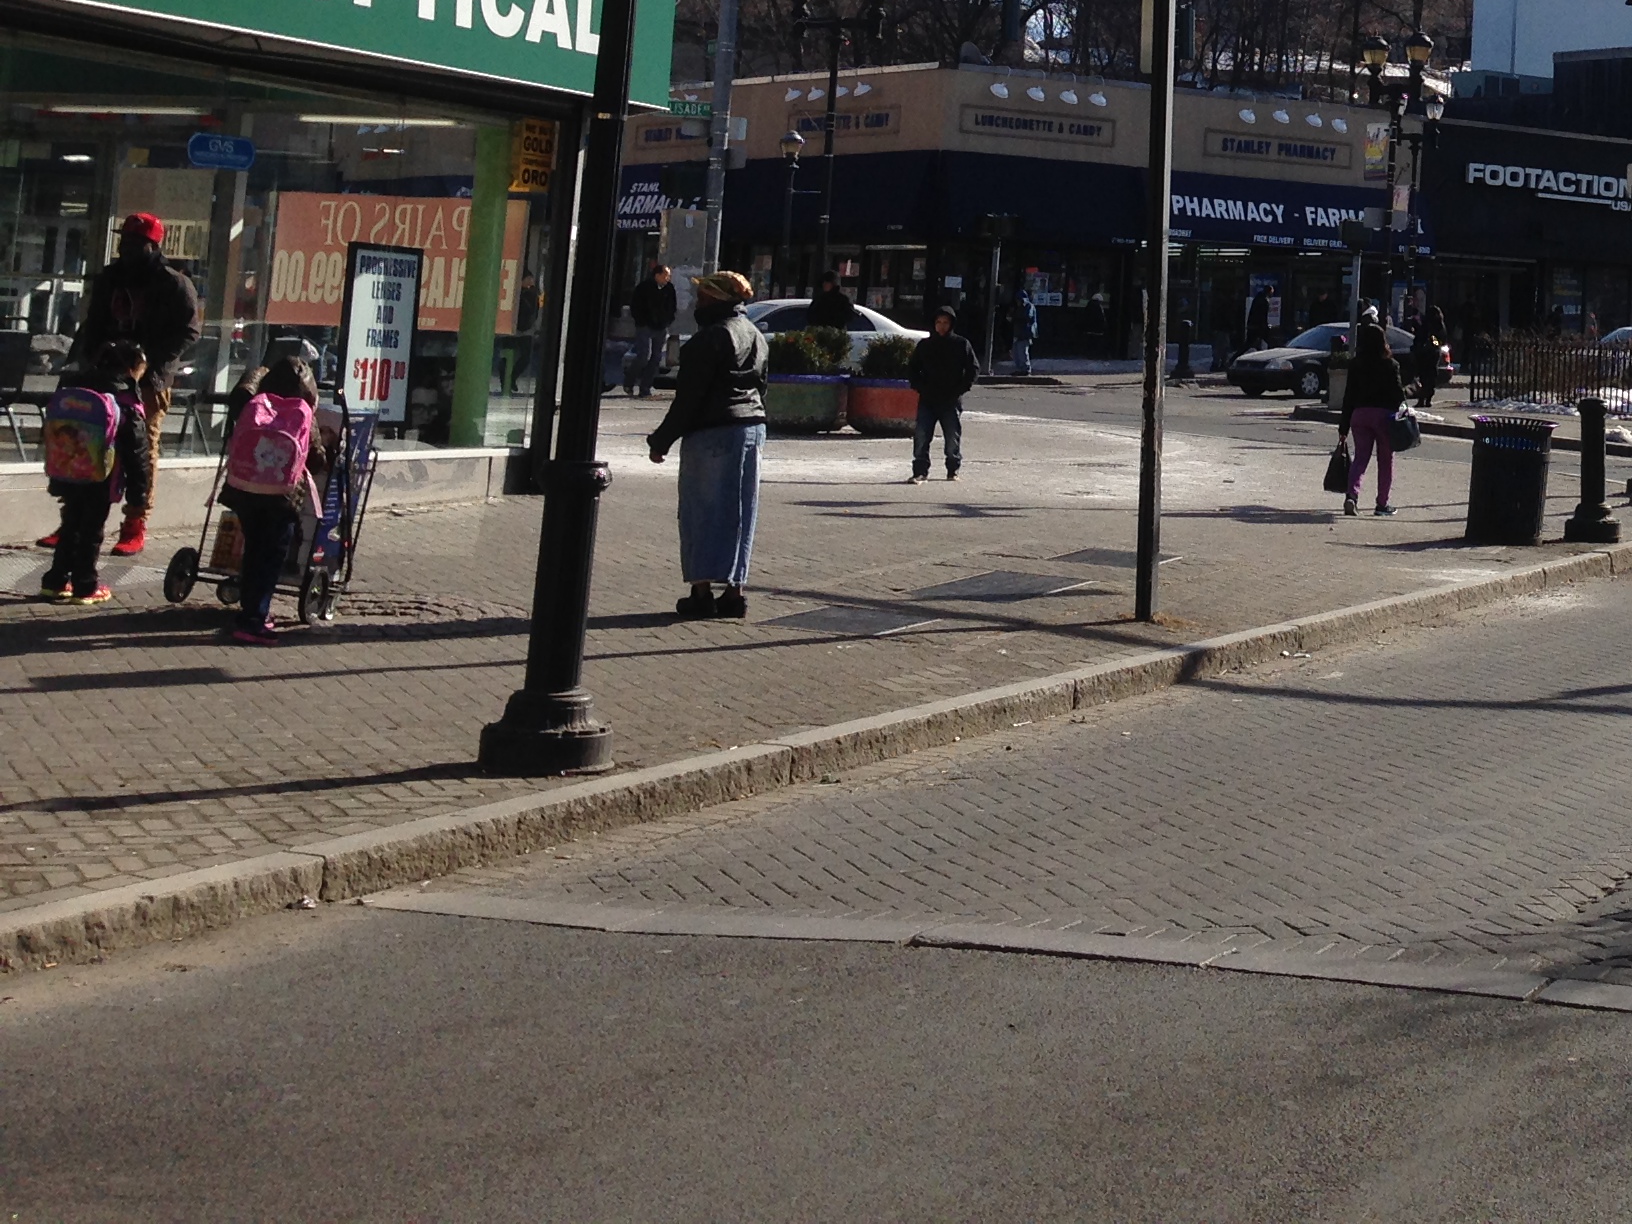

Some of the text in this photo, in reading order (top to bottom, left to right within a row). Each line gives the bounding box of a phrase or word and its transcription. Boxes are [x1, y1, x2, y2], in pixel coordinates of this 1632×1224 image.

[974, 113, 1054, 132] LUNCHEONETTE
[523, 135, 554, 154] GOLD
[1221, 137, 1336, 161] STANLEY PHARMACY
[521, 167, 549, 187] ORO
[1171, 194, 1285, 224] PHARMACY
[359, 254, 417, 279] PROGRESSIVE
[371, 280, 402, 302] LENSES
[375, 305, 394, 325] AND
[365, 328, 400, 349] FRAMES
